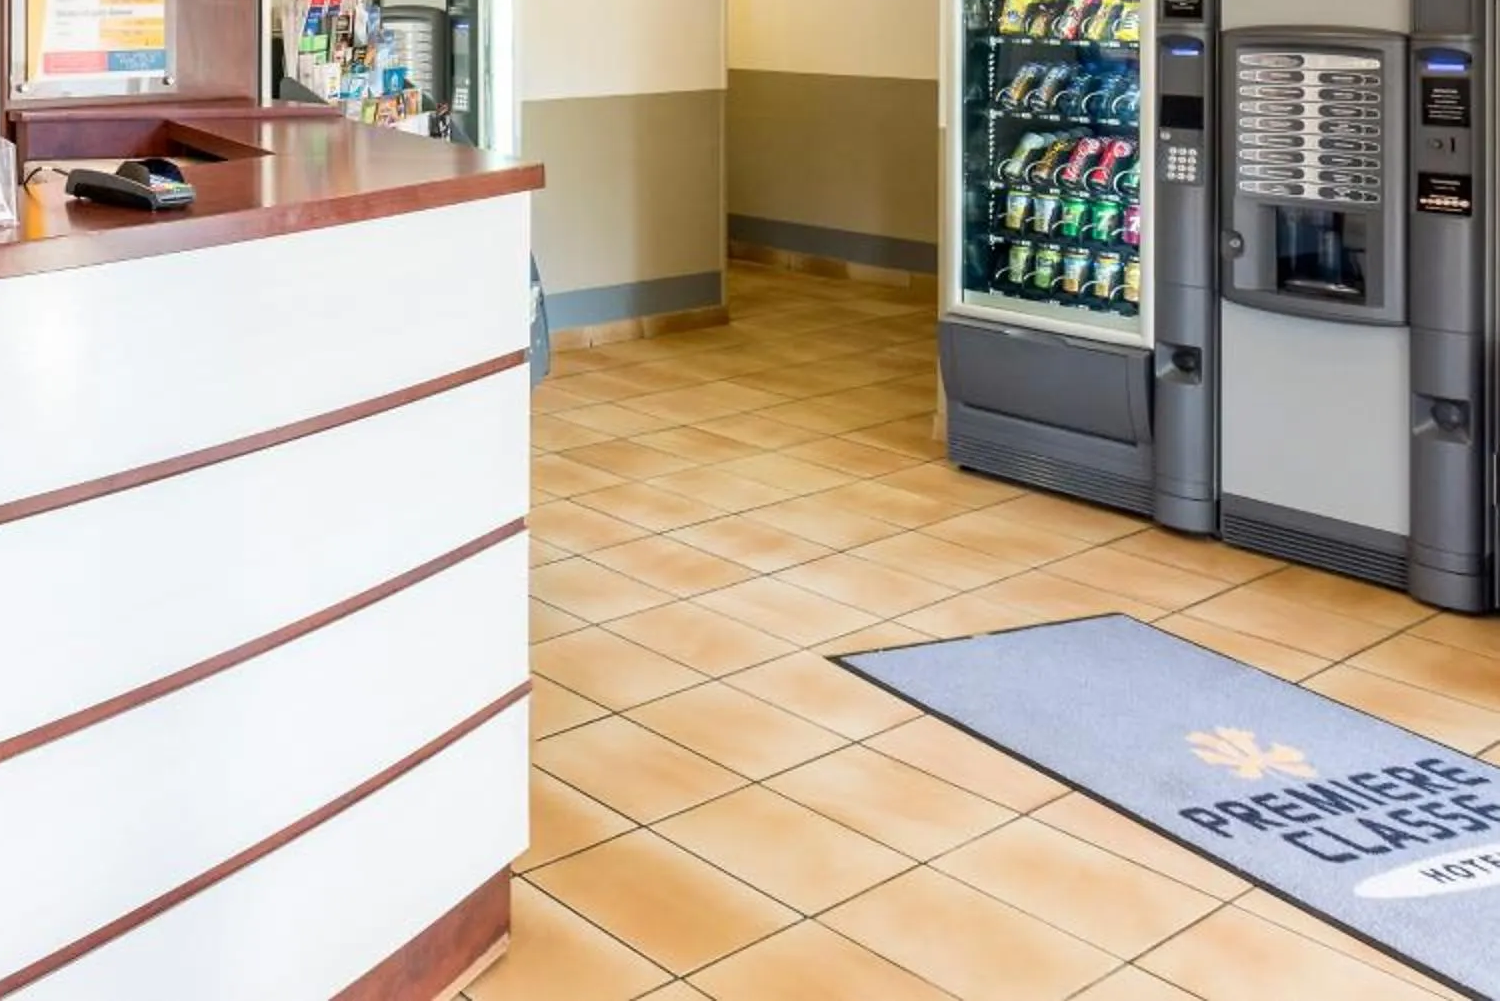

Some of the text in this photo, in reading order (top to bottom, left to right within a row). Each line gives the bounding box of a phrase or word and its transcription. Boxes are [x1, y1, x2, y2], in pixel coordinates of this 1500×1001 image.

[1179, 758, 1492, 839] PREMIERE
[1281, 794, 1500, 863] CLASSE
[1419, 852, 1500, 884] HOTE
